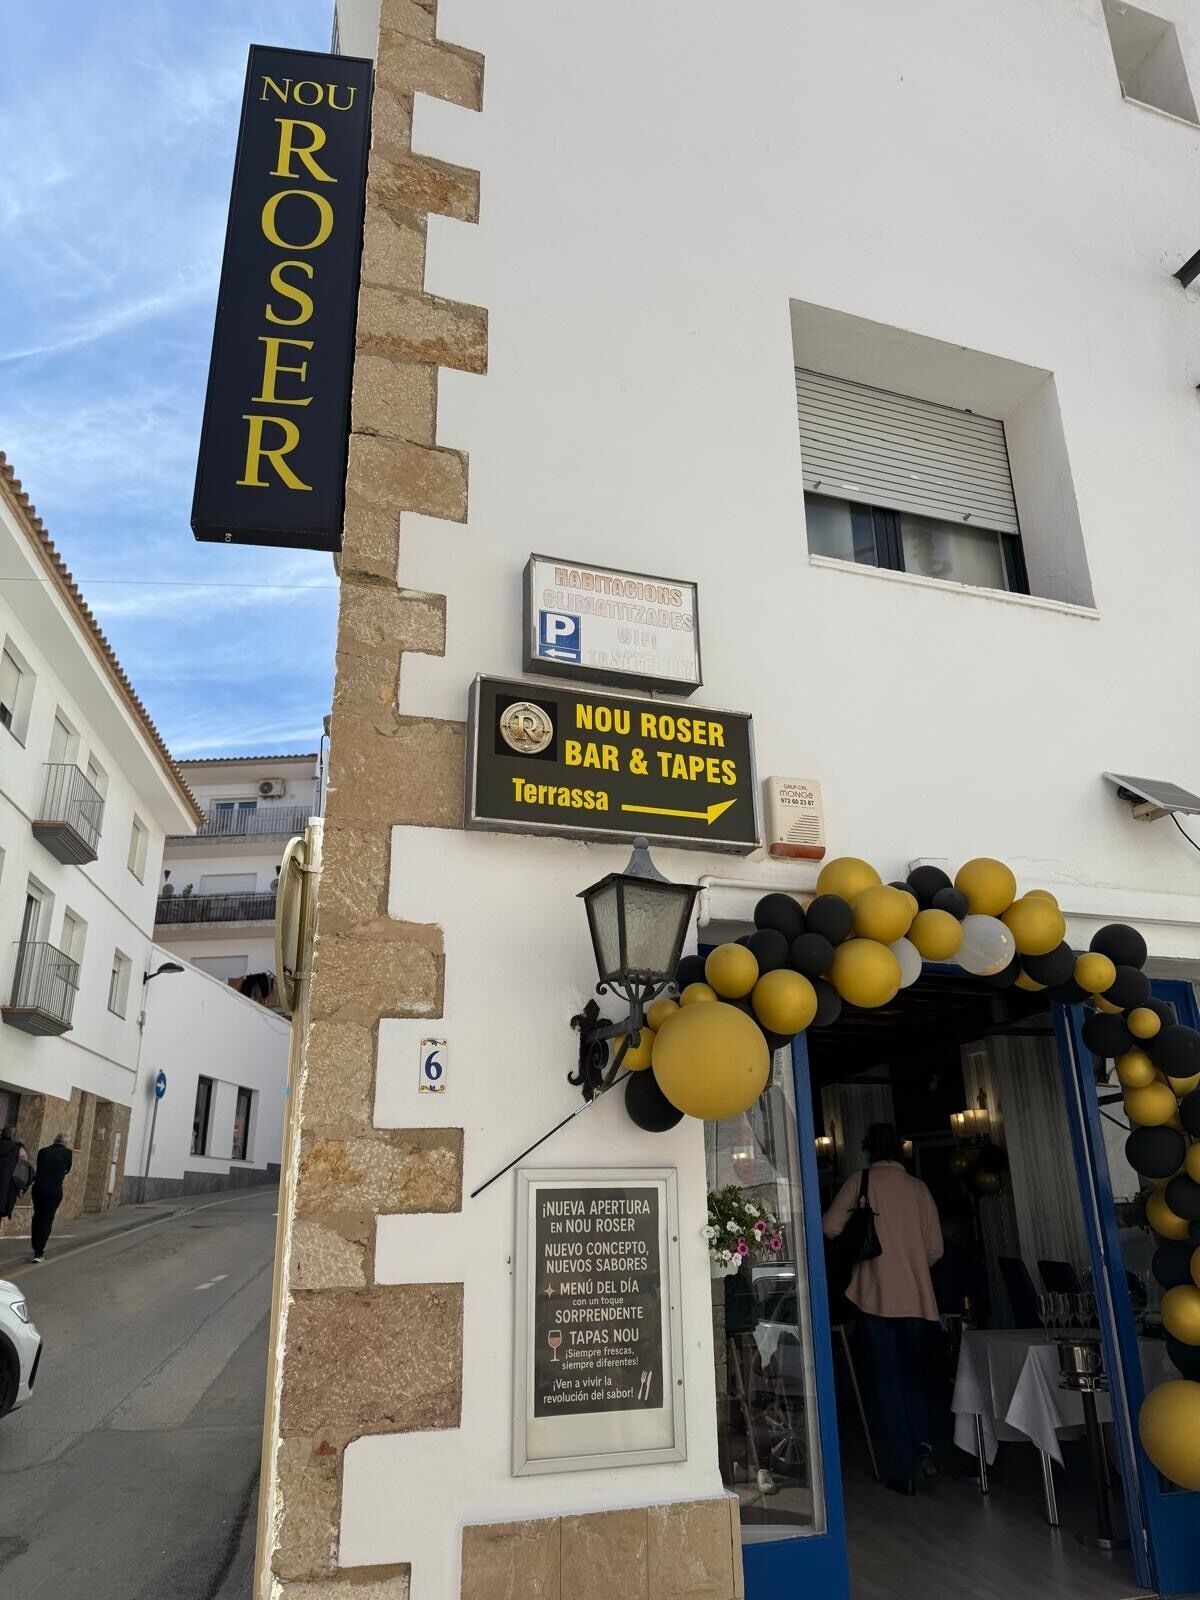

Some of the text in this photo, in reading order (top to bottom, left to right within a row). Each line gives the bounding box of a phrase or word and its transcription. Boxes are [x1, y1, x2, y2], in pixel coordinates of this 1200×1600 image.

[260, 76, 357, 111] NOU
[236, 117, 338, 491] ROSER
[554, 566, 683, 607] HABITACIONS
[543, 589, 694, 633] CLIMATITZADES
[546, 613, 576, 644] P
[617, 626, 658, 649] WIFI
[575, 703, 725, 748] NOU ROSER
[565, 740, 737, 786] BAR & TAPES
[512, 777, 609, 812] Terrassa
[424, 1050, 443, 1081] 6
[543, 1199, 651, 1218] ¡NUEVA APERTURA
[550, 1218, 635, 1233] EN NOU ROSER
[544, 1241, 649, 1257] NUEVO CONCEPTO,
[546, 1257, 648, 1273] NUEVOS SABORES
[560, 1277, 640, 1296] MENÚ DEL DÍA
[572, 1298, 587, 1306] con
[601, 1296, 624, 1306] toque
[555, 1306, 644, 1324] SORPRENDENTE
[569, 1328, 640, 1345] TAPAS NOU
[565, 1346, 635, 1359] ¡Siempre frescas,
[562, 1357, 639, 1371] siempre diferentes!
[553, 1375, 612, 1392] ¡Ven a vivir la
[543, 1386, 634, 1404] revolución del sabor!
